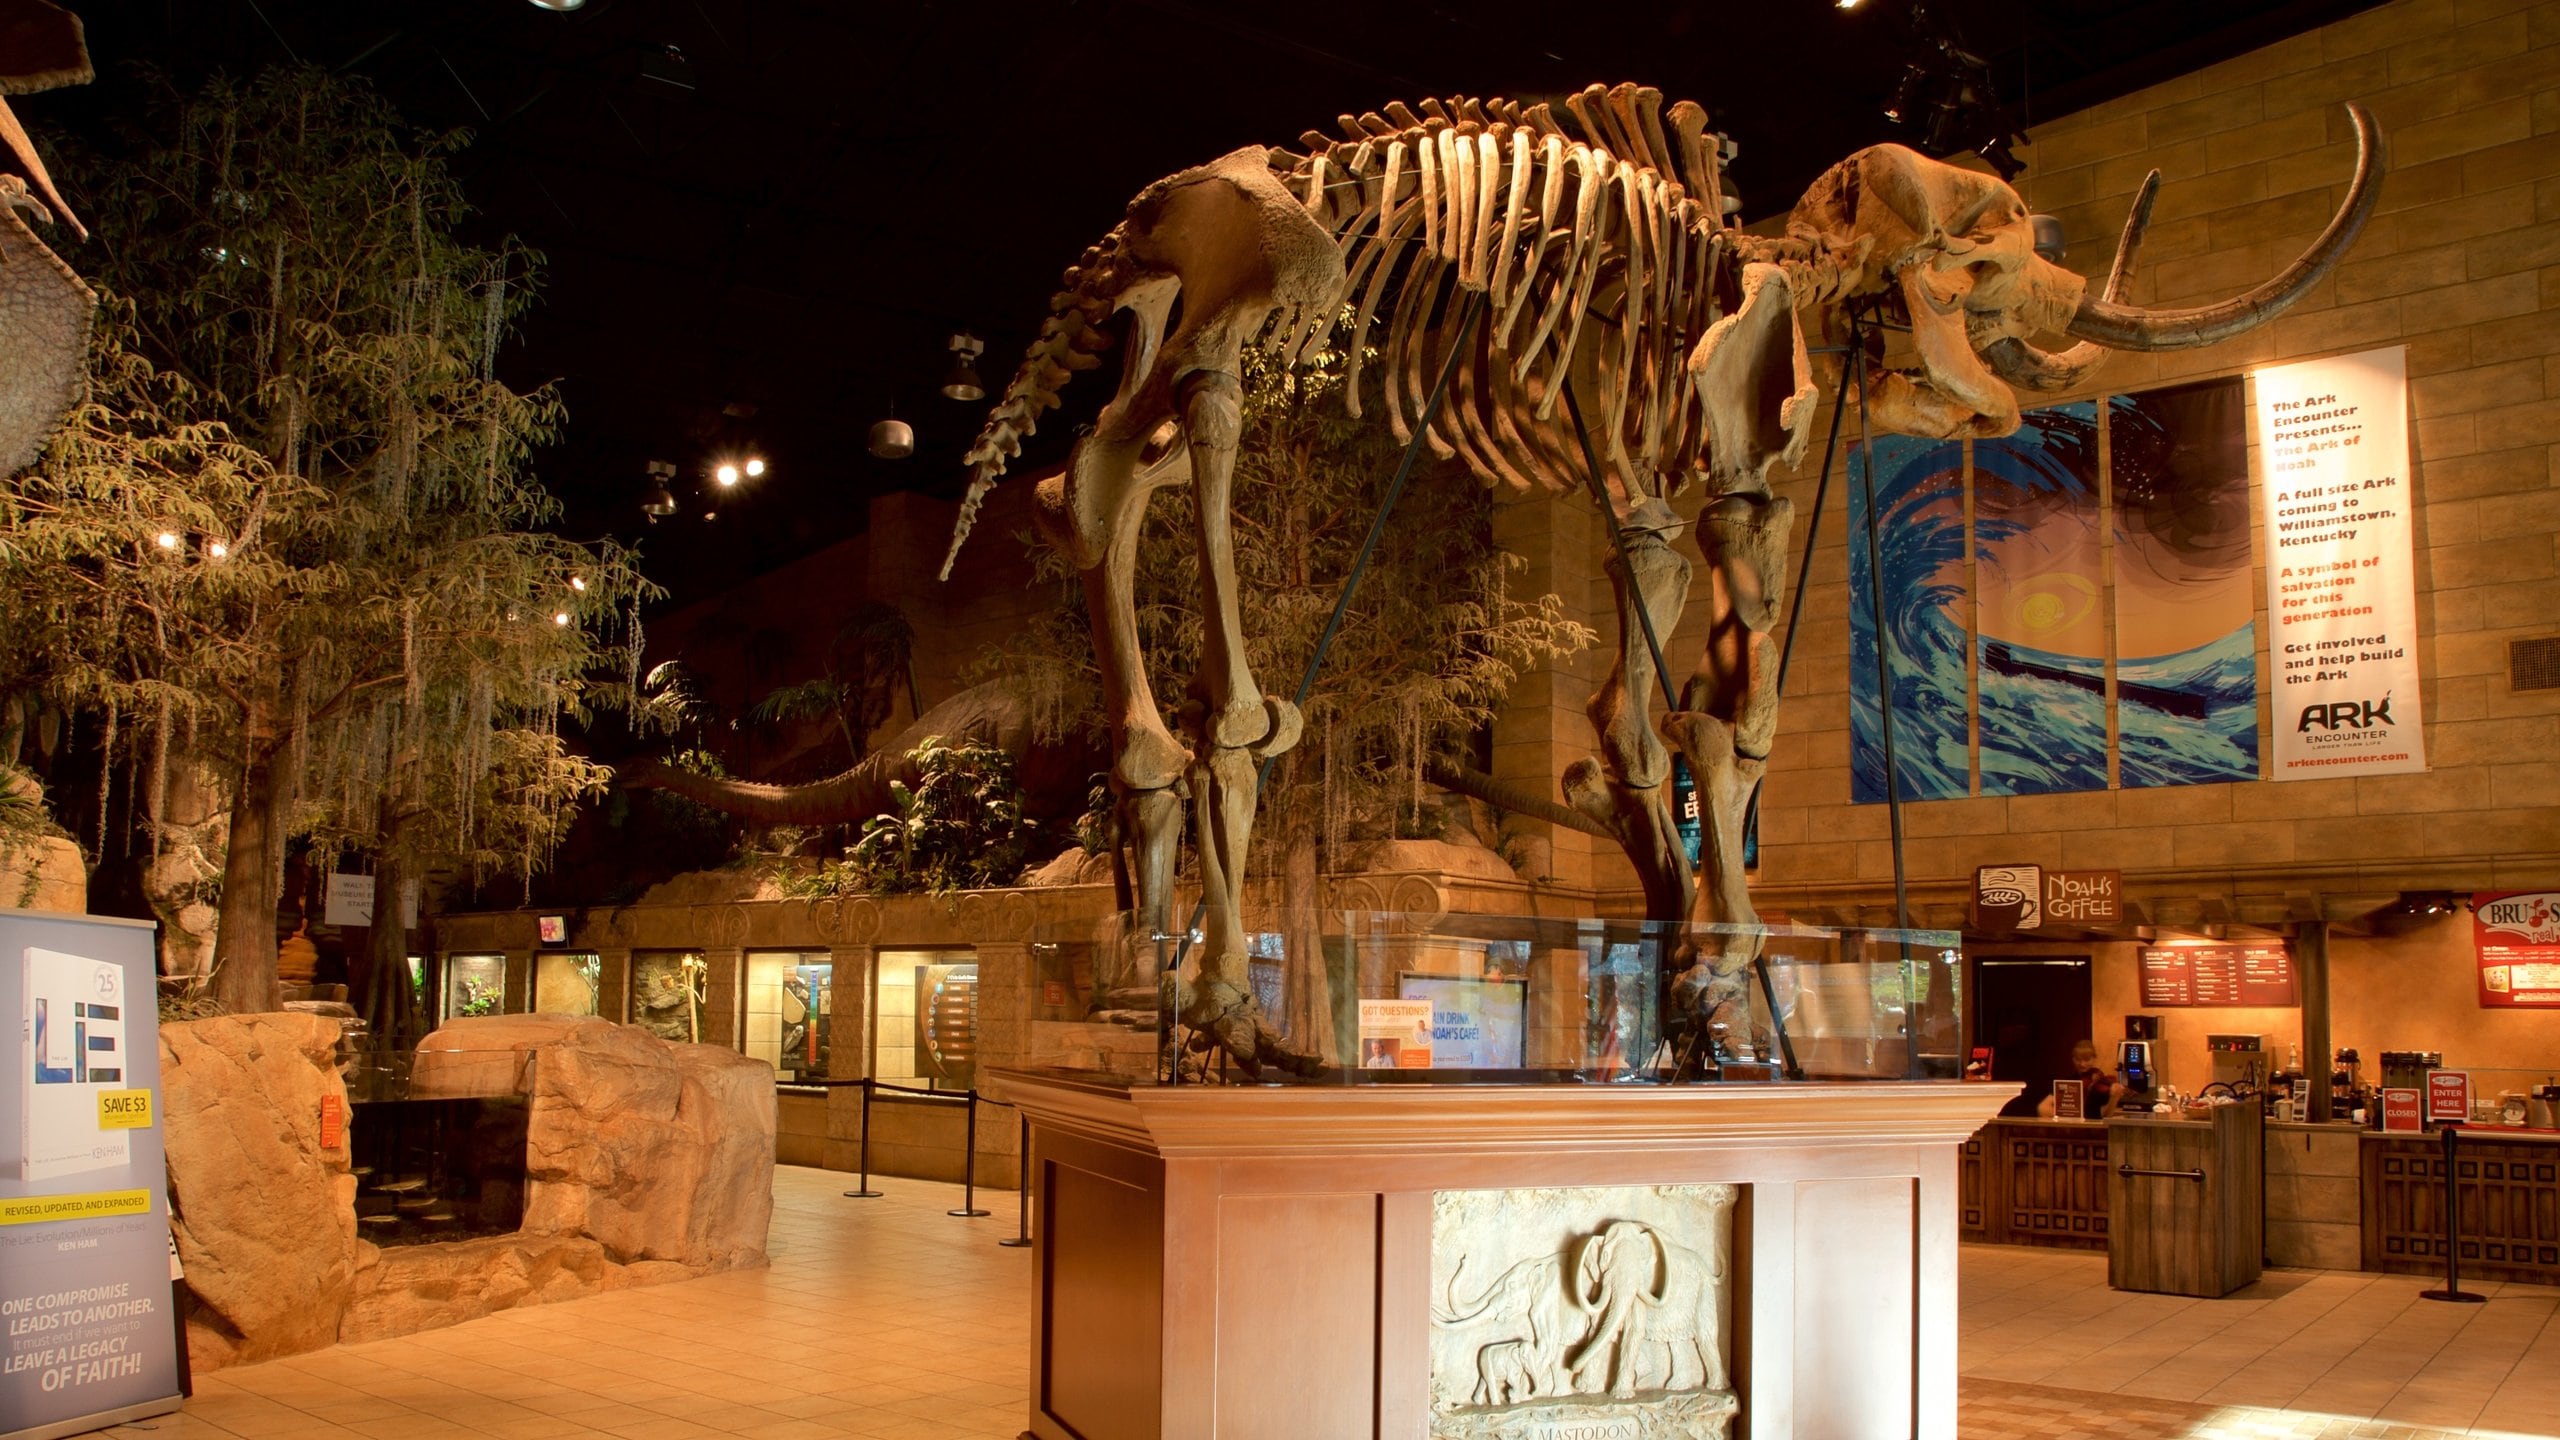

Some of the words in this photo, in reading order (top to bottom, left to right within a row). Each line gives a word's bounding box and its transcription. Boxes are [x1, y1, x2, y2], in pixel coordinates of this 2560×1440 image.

[2272, 401, 2301, 413] The
[2304, 394, 2337, 408] Ark
[2273, 405, 2358, 427] Encounter
[2274, 423, 2363, 442] Presents...
[2274, 445, 2303, 457] The
[2307, 439, 2339, 453] Ark
[2343, 434, 2361, 446] of
[2276, 459, 2316, 472] Noah
[2277, 492, 2290, 503] A
[2294, 487, 2323, 500] full
[2327, 482, 2359, 495] size
[2363, 476, 2397, 490] Ark
[2278, 501, 2337, 518] coming
[2342, 498, 2359, 508] to
[2278, 508, 2397, 533] Williamstown,
[2279, 528, 2358, 548] Kentucky
[2280, 567, 2293, 578] A
[2298, 558, 2357, 577] symbol
[2362, 556, 2380, 568] of
[2281, 576, 2356, 593] salvation
[2282, 596, 2308, 609] for
[2312, 592, 2343, 605] this
[2282, 604, 2374, 625] generation
[2284, 643, 2311, 654] Get
[2316, 634, 2387, 651] involved
[2285, 656, 2314, 669] and
[2319, 652, 2356, 667] help
[2360, 648, 2404, 662] build
[2286, 673, 2312, 685] the
[2315, 670, 2348, 682] Ark
[2297, 690, 2396, 733] ARK
[2306, 730, 2387, 744] ENCOUNTER
[2287, 752, 2409, 768] arkencounter.com
[98, 974, 113, 992] 25
[1362, 1006, 1379, 1016] GOT
[1380, 1006, 1430, 1016] QUESTIONS?
[1446, 1011, 1470, 1024] DRINK
[2433, 1089, 2462, 1097] ENTER
[103, 1097, 132, 1113] SAVE
[133, 1096, 146, 1113] $3
[2386, 1109, 2417, 1117] CLOSED
[5, 1205, 42, 1216] REVISED,
[44, 1202, 83, 1213] UPDATED,
[85, 1200, 103, 1209] AND
[104, 1197, 145, 1208] EXPANDED
[58, 1241, 76, 1252] KEN
[78, 1239, 98, 1249] HAM
[2, 1297, 33, 1316] ONE
[35, 1283, 129, 1311] COMPROMISE
[9, 1314, 60, 1336] LEADS
[63, 1309, 83, 1326] TO
[84, 1298, 155, 1323] ANOTHER.
[13, 1339, 21, 1351] It
[23, 1335, 50, 1350] must
[52, 1330, 73, 1345] end
[75, 1328, 83, 1342] if
[84, 1328, 100, 1337] we
[103, 1322, 129, 1335] want
[130, 1319, 141, 1331] to
[4, 1349, 54, 1374] LEAVE
[56, 1347, 68, 1363] A
[70, 1336, 129, 1361] LEGACY
[41, 1366, 73, 1392] OF
[75, 1352, 143, 1386] FAITH!
[1540, 1424, 1632, 1440] MASTODON
